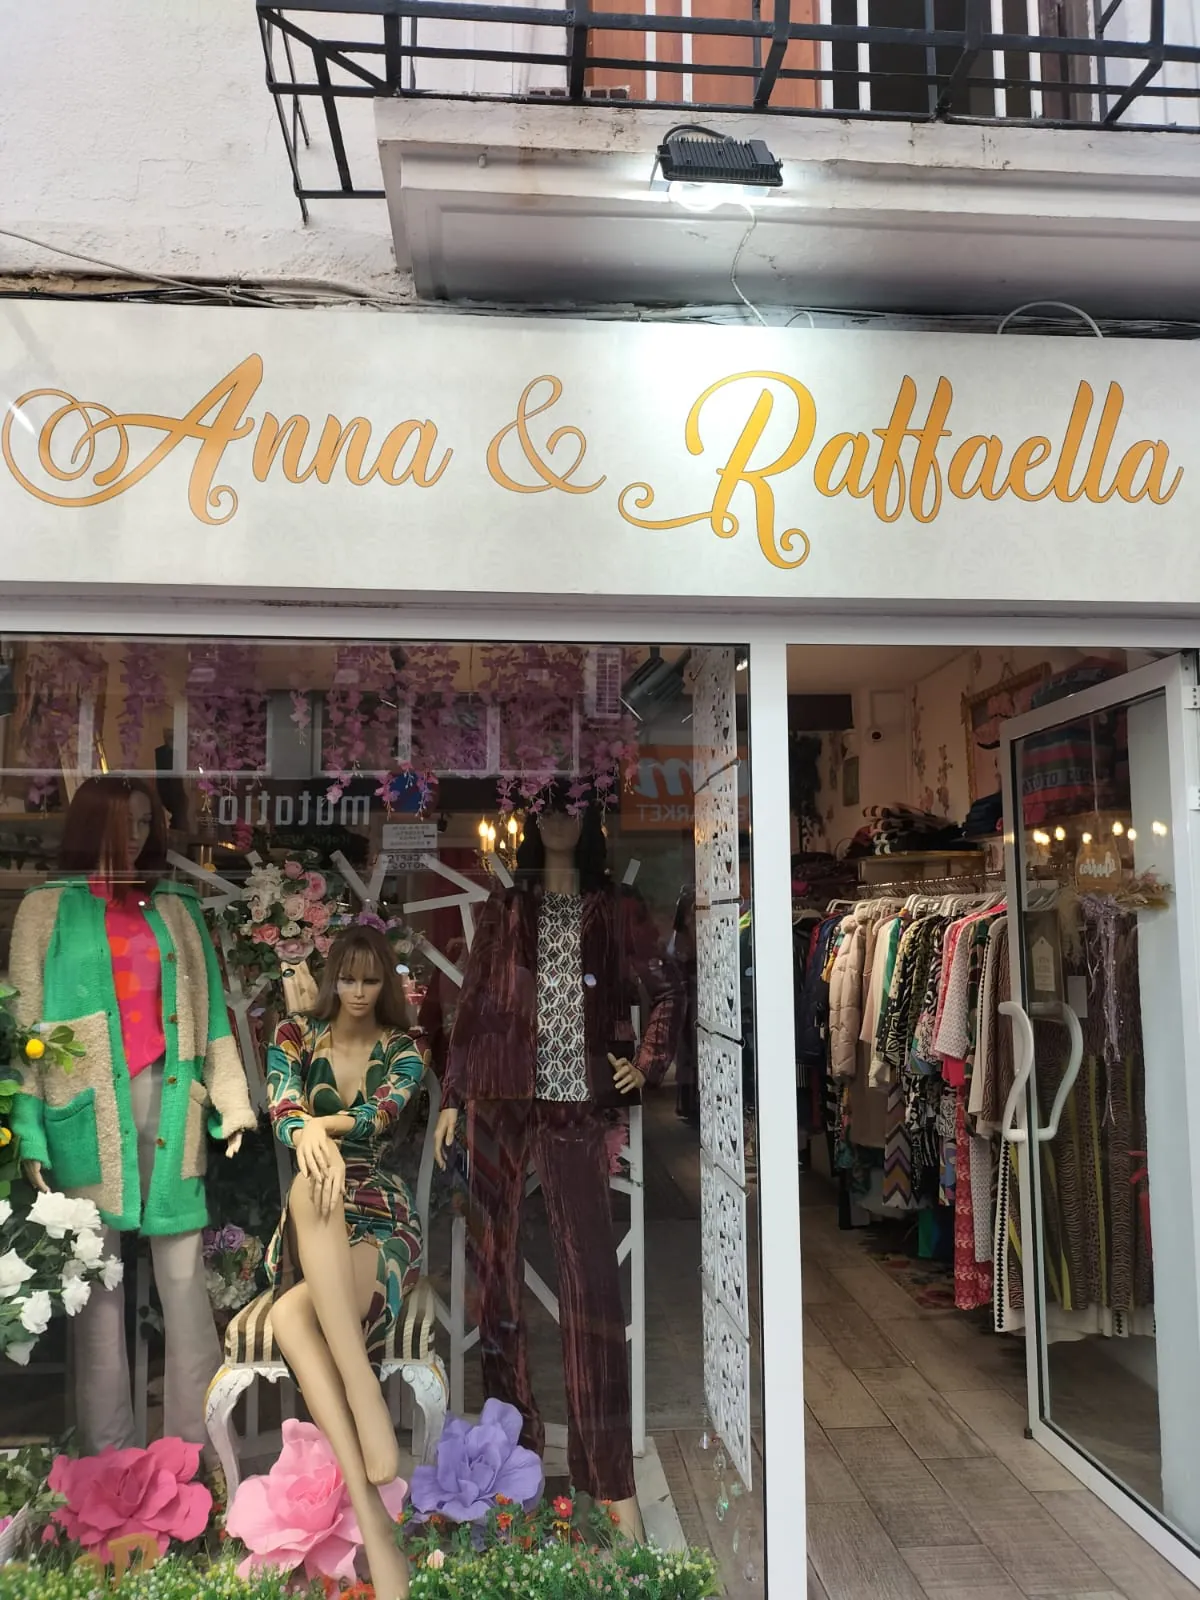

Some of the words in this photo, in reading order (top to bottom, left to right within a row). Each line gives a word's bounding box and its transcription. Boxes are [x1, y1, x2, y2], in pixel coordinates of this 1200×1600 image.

[2, 353, 454, 526] Anna
[486, 374, 607, 494] &
[618, 370, 1185, 570] Raffaella
